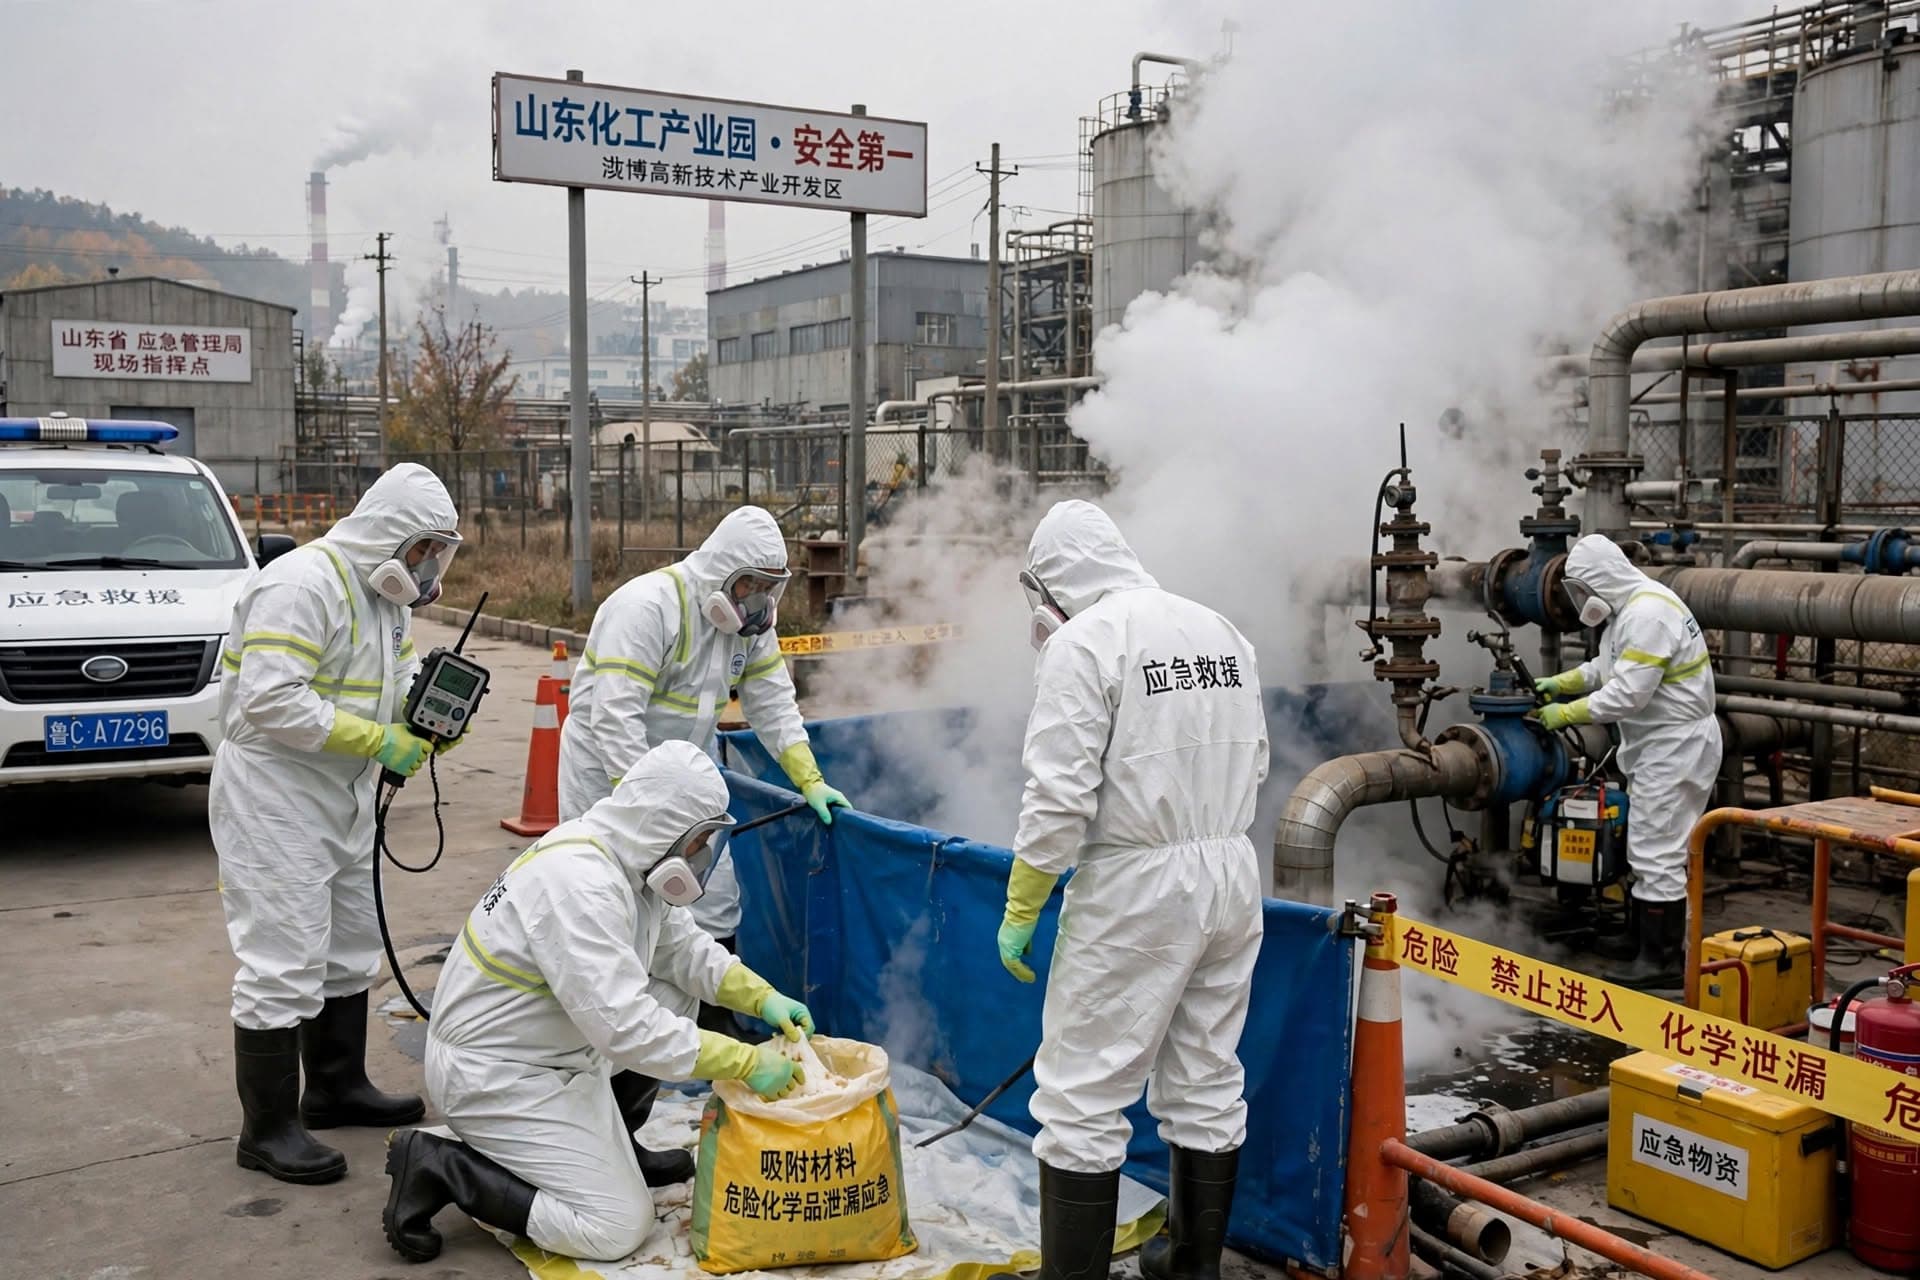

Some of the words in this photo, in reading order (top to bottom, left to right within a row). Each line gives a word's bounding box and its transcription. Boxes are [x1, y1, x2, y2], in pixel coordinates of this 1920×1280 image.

[94, 353, 210, 376] 现场指挥点
[8, 588, 185, 608] 应急救援
[1142, 655, 1242, 696] 应急救援
[1401, 926, 1460, 977] 危险
[1490, 954, 1624, 1033] 禁止进入
[1660, 1011, 1827, 1100] 化学泄漏
[760, 1142, 857, 1184] 吸附材料
[1639, 1127, 1740, 1187] 应急物资
[723, 1173, 891, 1222] 危险化学品泄漏应急
